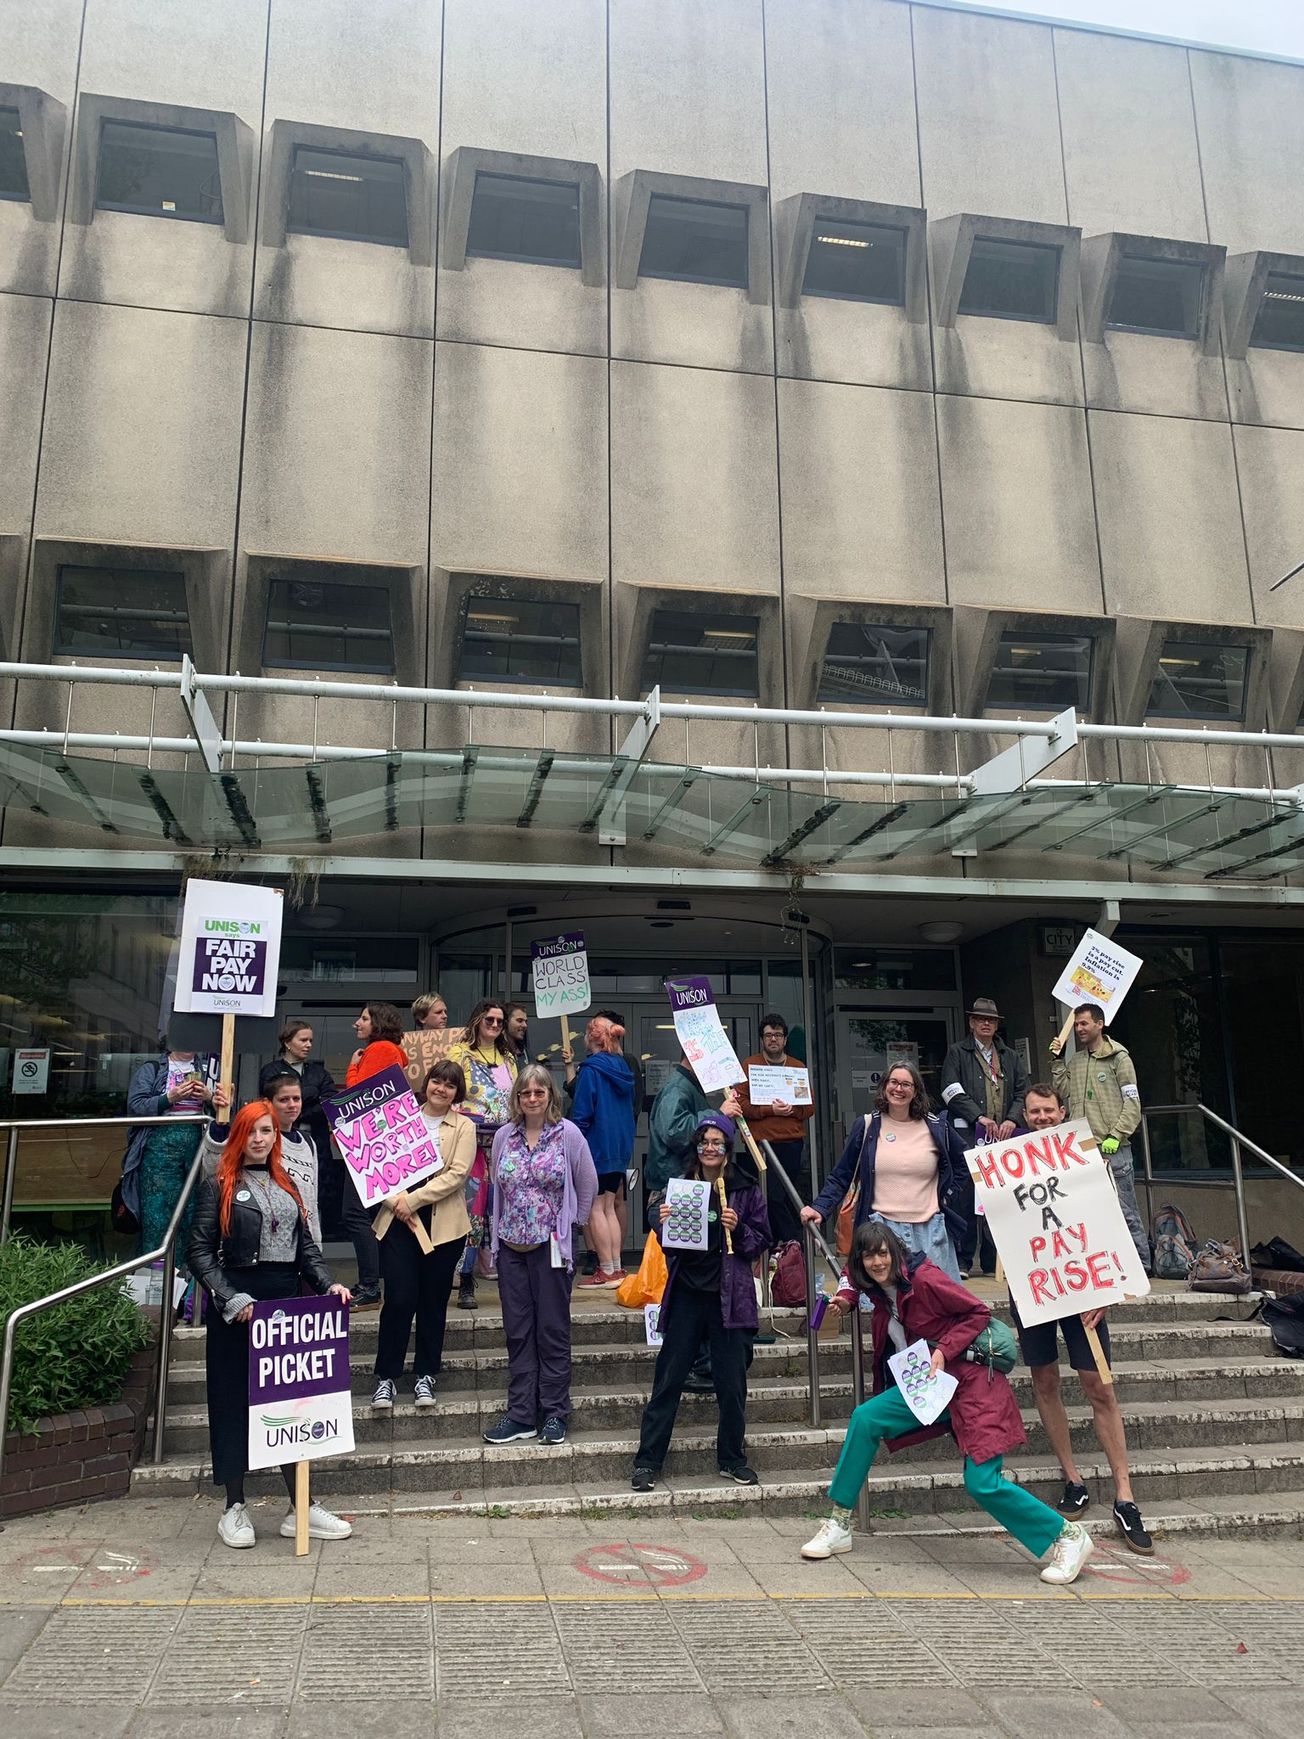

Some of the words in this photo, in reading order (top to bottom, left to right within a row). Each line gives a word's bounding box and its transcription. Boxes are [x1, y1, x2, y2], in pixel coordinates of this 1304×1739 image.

[205, 920, 260, 934] UNISN
[1046, 934, 1073, 945] CITY
[205, 939, 256, 958] FAIR
[539, 940, 577, 956] UNISON
[1099, 952, 1112, 962] pay
[1112, 959, 1126, 969] rise
[210, 957, 253, 974] PAY
[535, 956, 585, 977] WORLD
[1084, 956, 1113, 977] Inflation
[1113, 973, 1120, 981] is
[1098, 958, 1111, 968] pay
[202, 973, 257, 992] NOW
[535, 971, 586, 990] CLASS
[213, 999, 241, 1007] UNISON
[536, 991, 557, 1007] MY
[560, 981, 589, 1003] ASS!
[676, 988, 708, 1006] UNISON
[338, 1080, 396, 1119] UNISON
[335, 1092, 420, 1150] WE'RE
[345, 1116, 428, 1174] WORTH
[365, 1140, 437, 1200] MORE!
[975, 1130, 1090, 1189] HONK
[1013, 1175, 1069, 1211] FOR
[1041, 1204, 1063, 1231] A
[1029, 1222, 1089, 1264] PAY
[1027, 1250, 1128, 1307] RISE!
[252, 1310, 347, 1350] OFFICIAL
[259, 1348, 336, 1388] PICKET
[266, 1418, 338, 1448] UNISN
